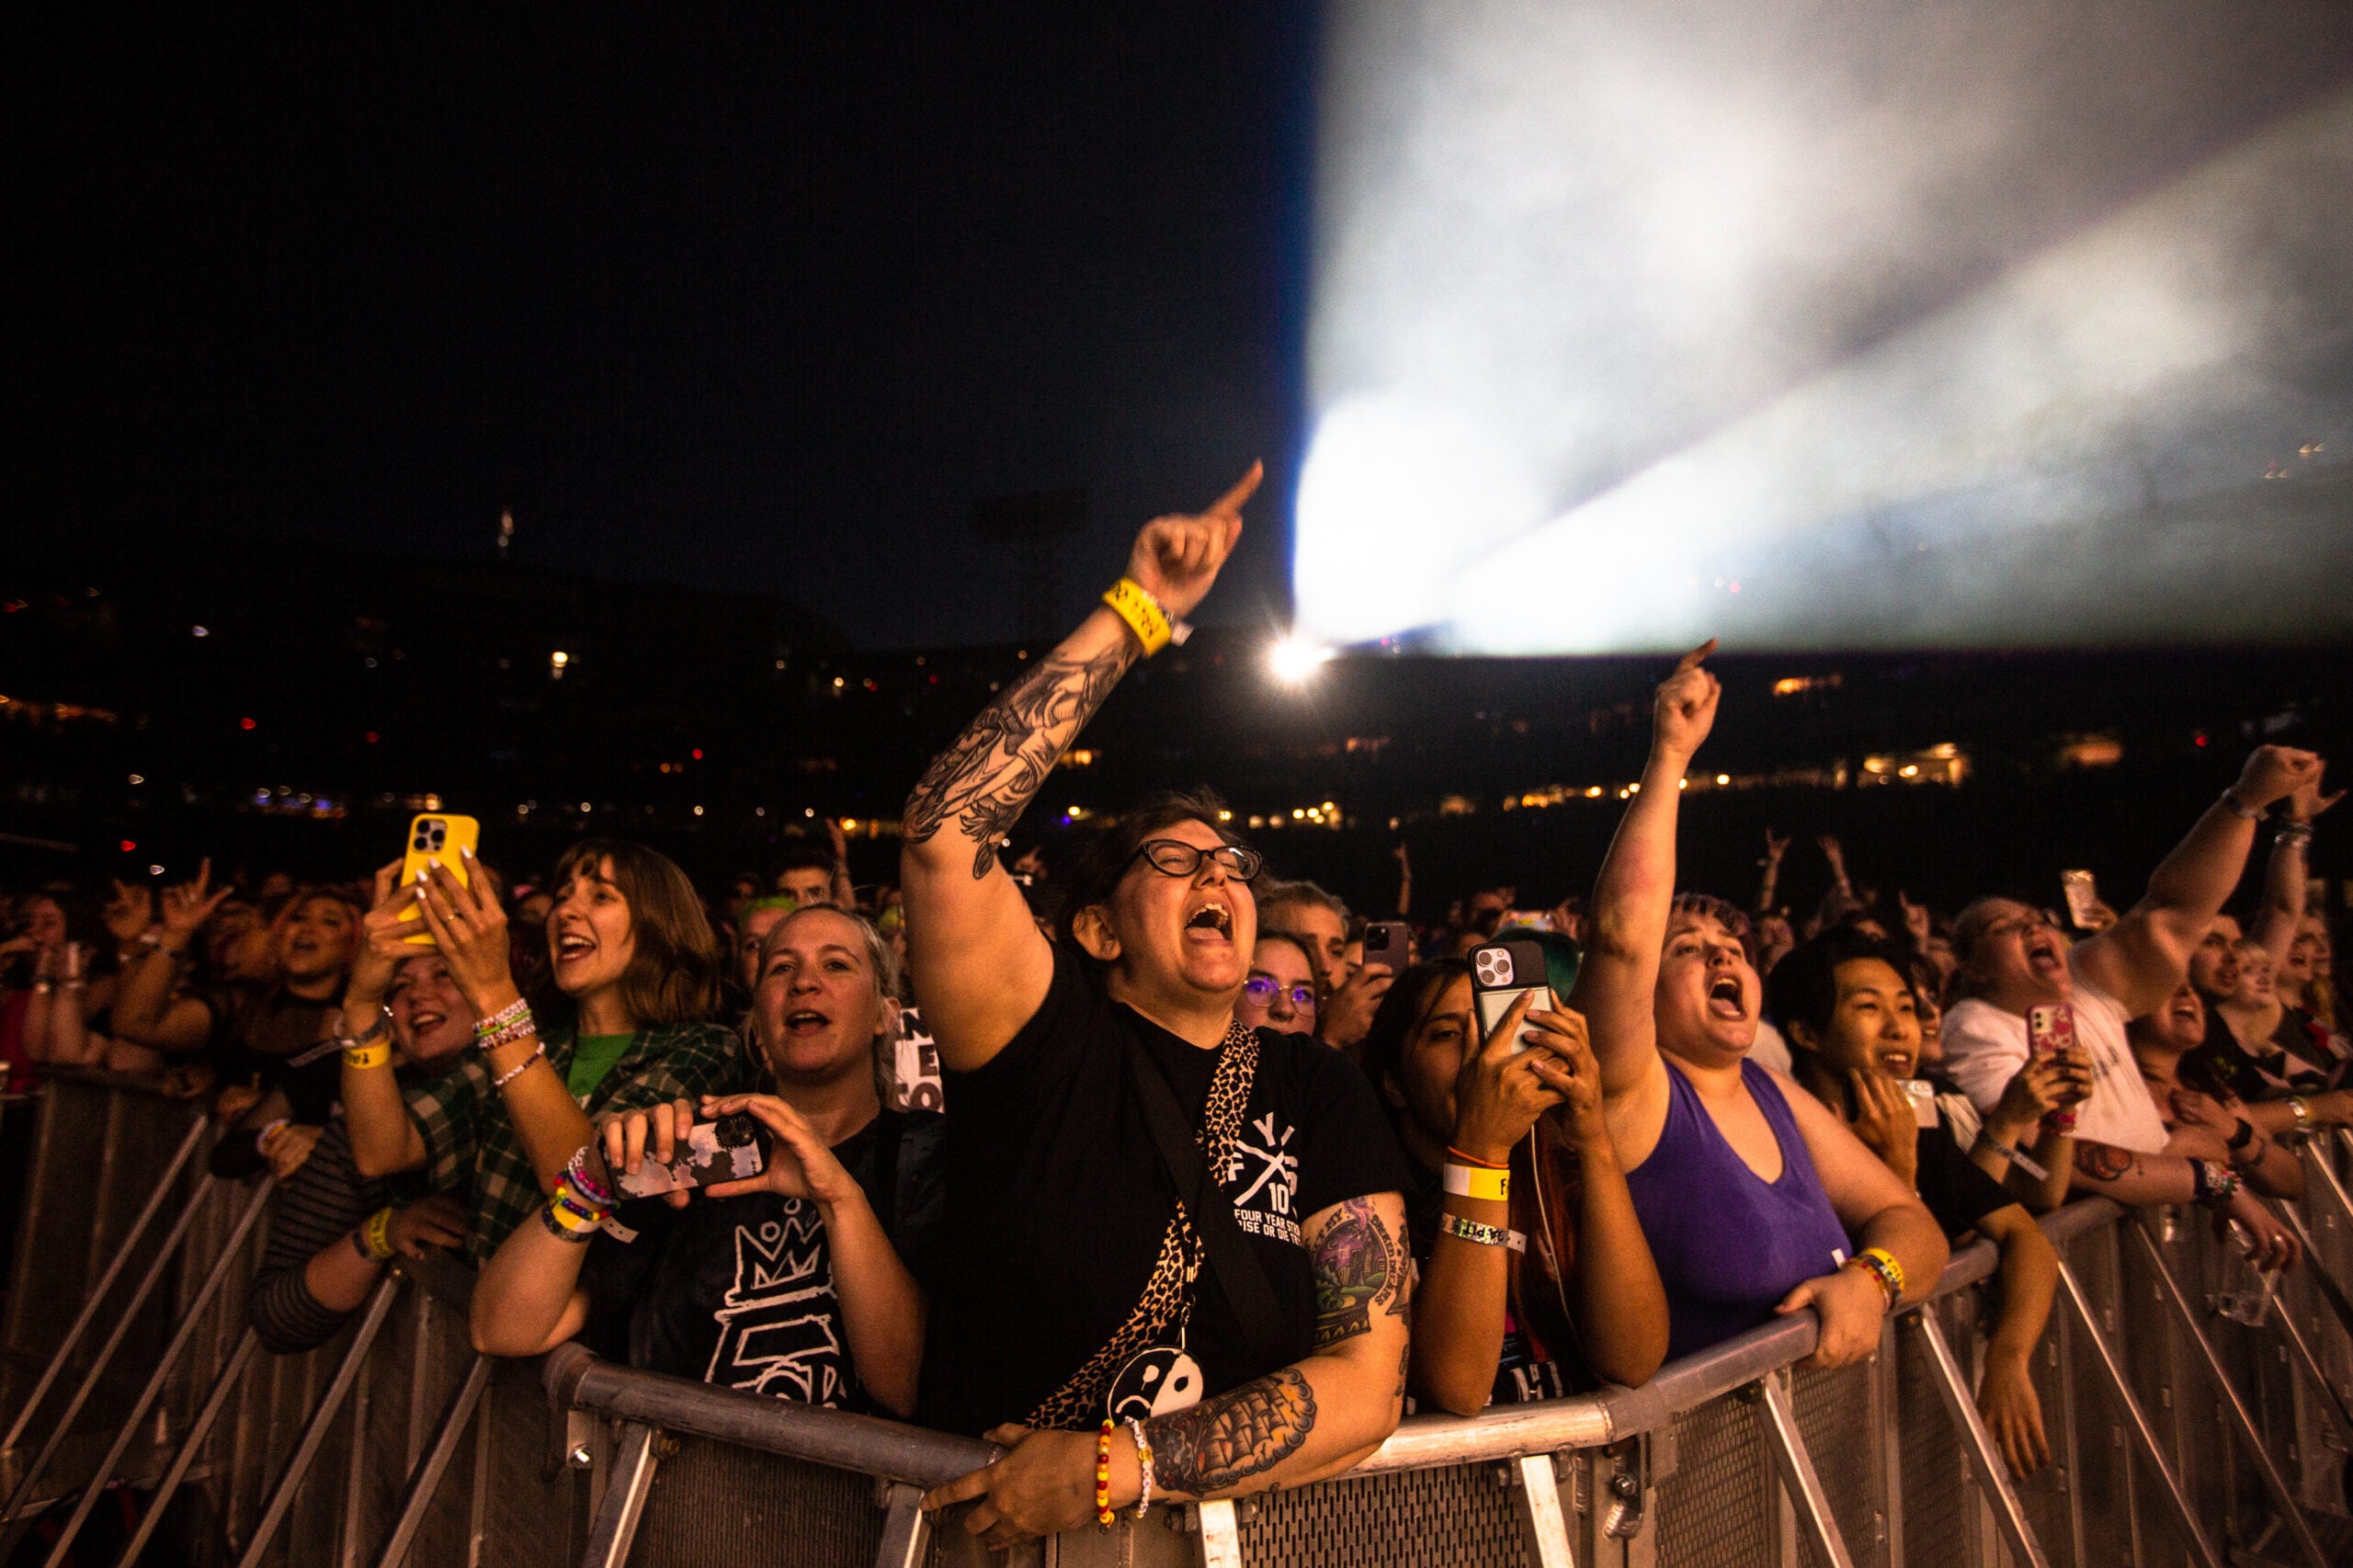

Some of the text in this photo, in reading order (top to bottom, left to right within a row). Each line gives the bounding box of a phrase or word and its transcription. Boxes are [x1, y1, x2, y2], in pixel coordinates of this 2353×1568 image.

[1233, 1209, 1263, 1223] FOUR
[1264, 1212, 1286, 1230] YEAR
[1263, 1223, 1276, 1238] OR
[1277, 1228, 1290, 1243] DIE
